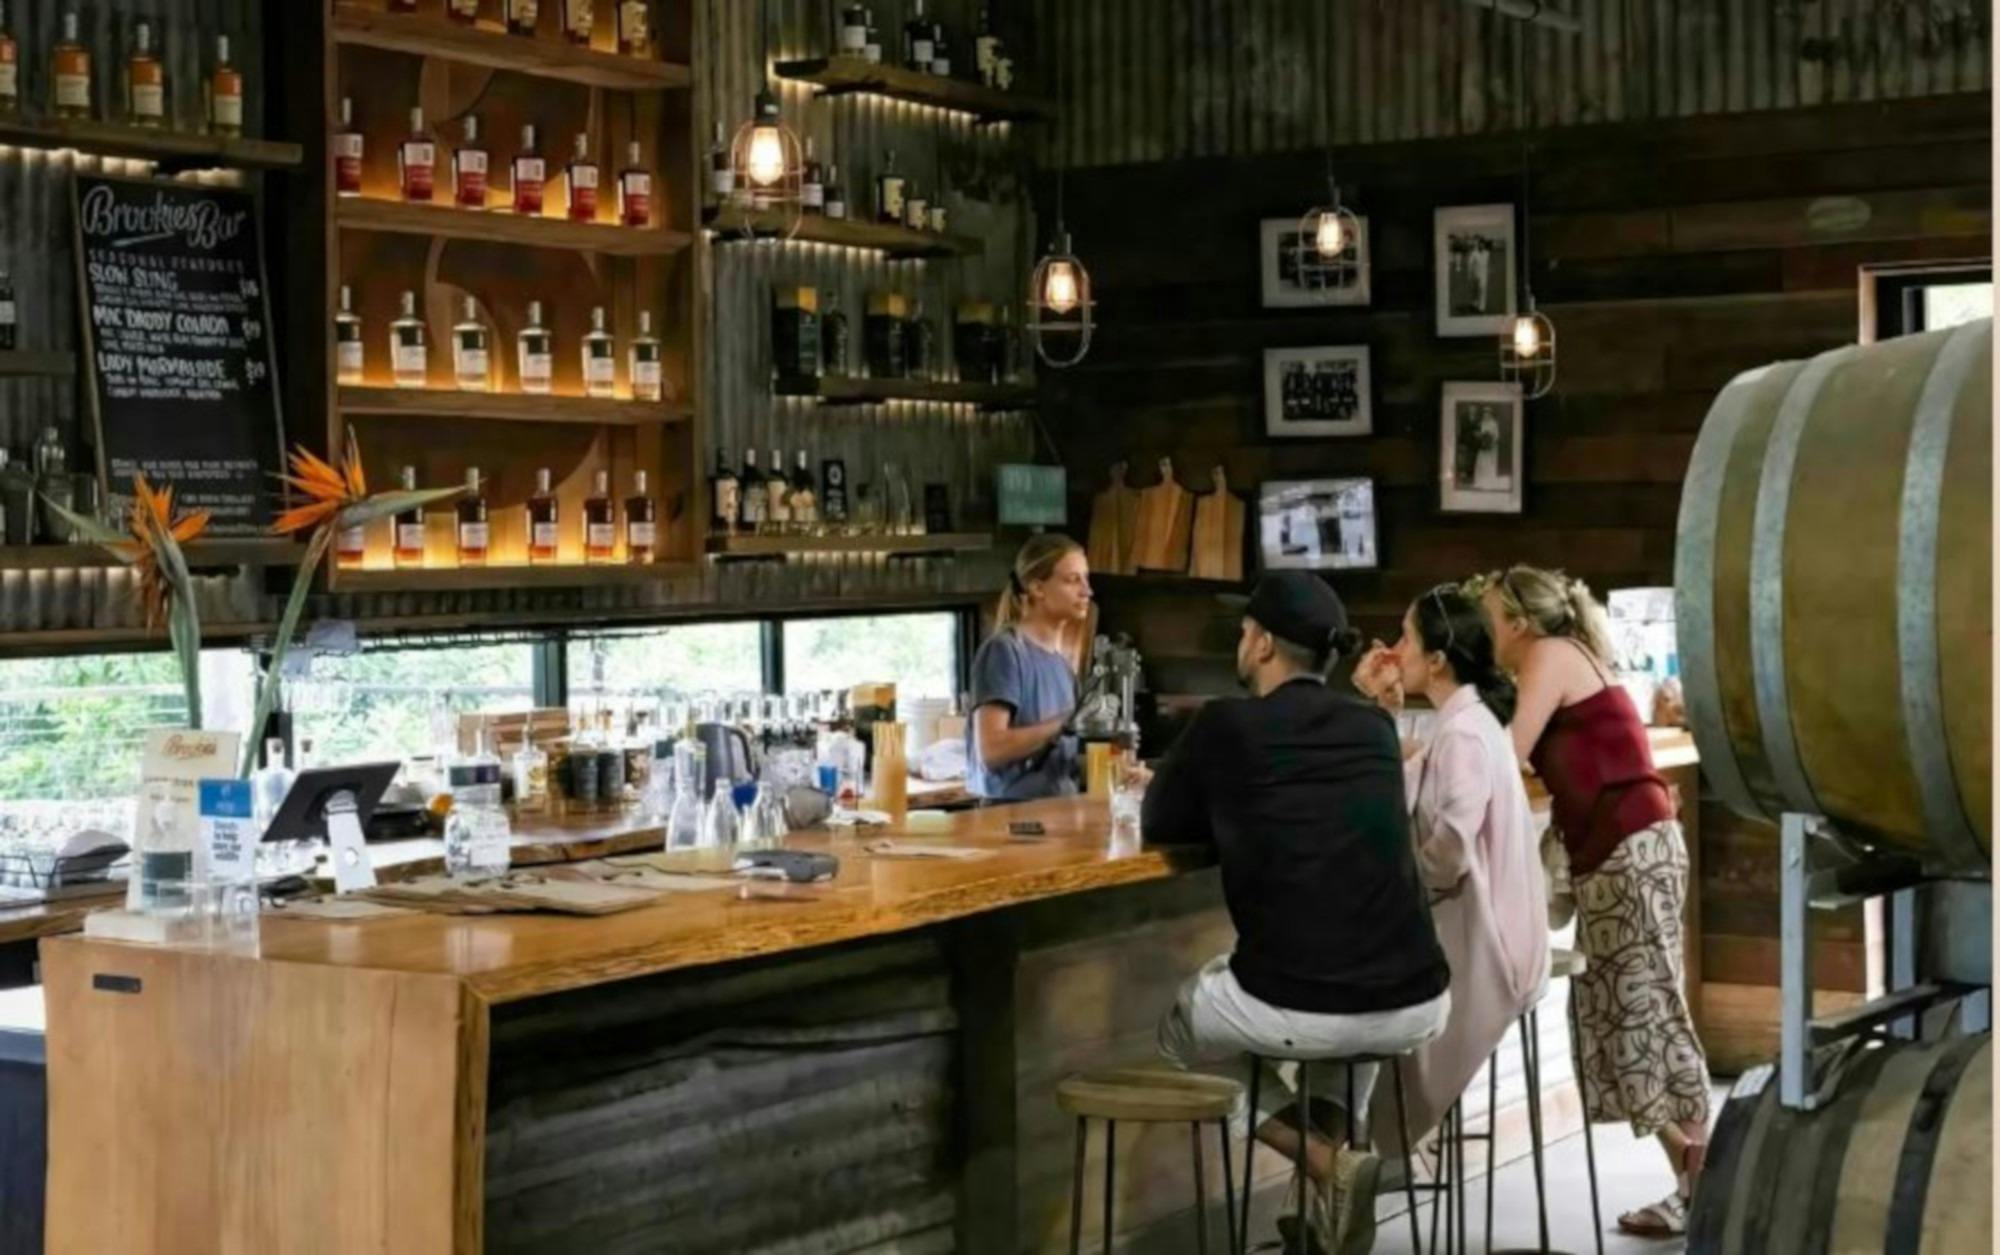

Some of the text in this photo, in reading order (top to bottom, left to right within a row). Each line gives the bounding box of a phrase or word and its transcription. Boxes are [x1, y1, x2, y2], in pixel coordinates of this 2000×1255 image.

[187, 199, 246, 249] Bar
[88, 262, 129, 285] SLOW
[132, 266, 179, 291] SLING
[92, 304, 123, 327] MAC
[125, 308, 172, 331] DADDY
[97, 351, 133, 373] LADY
